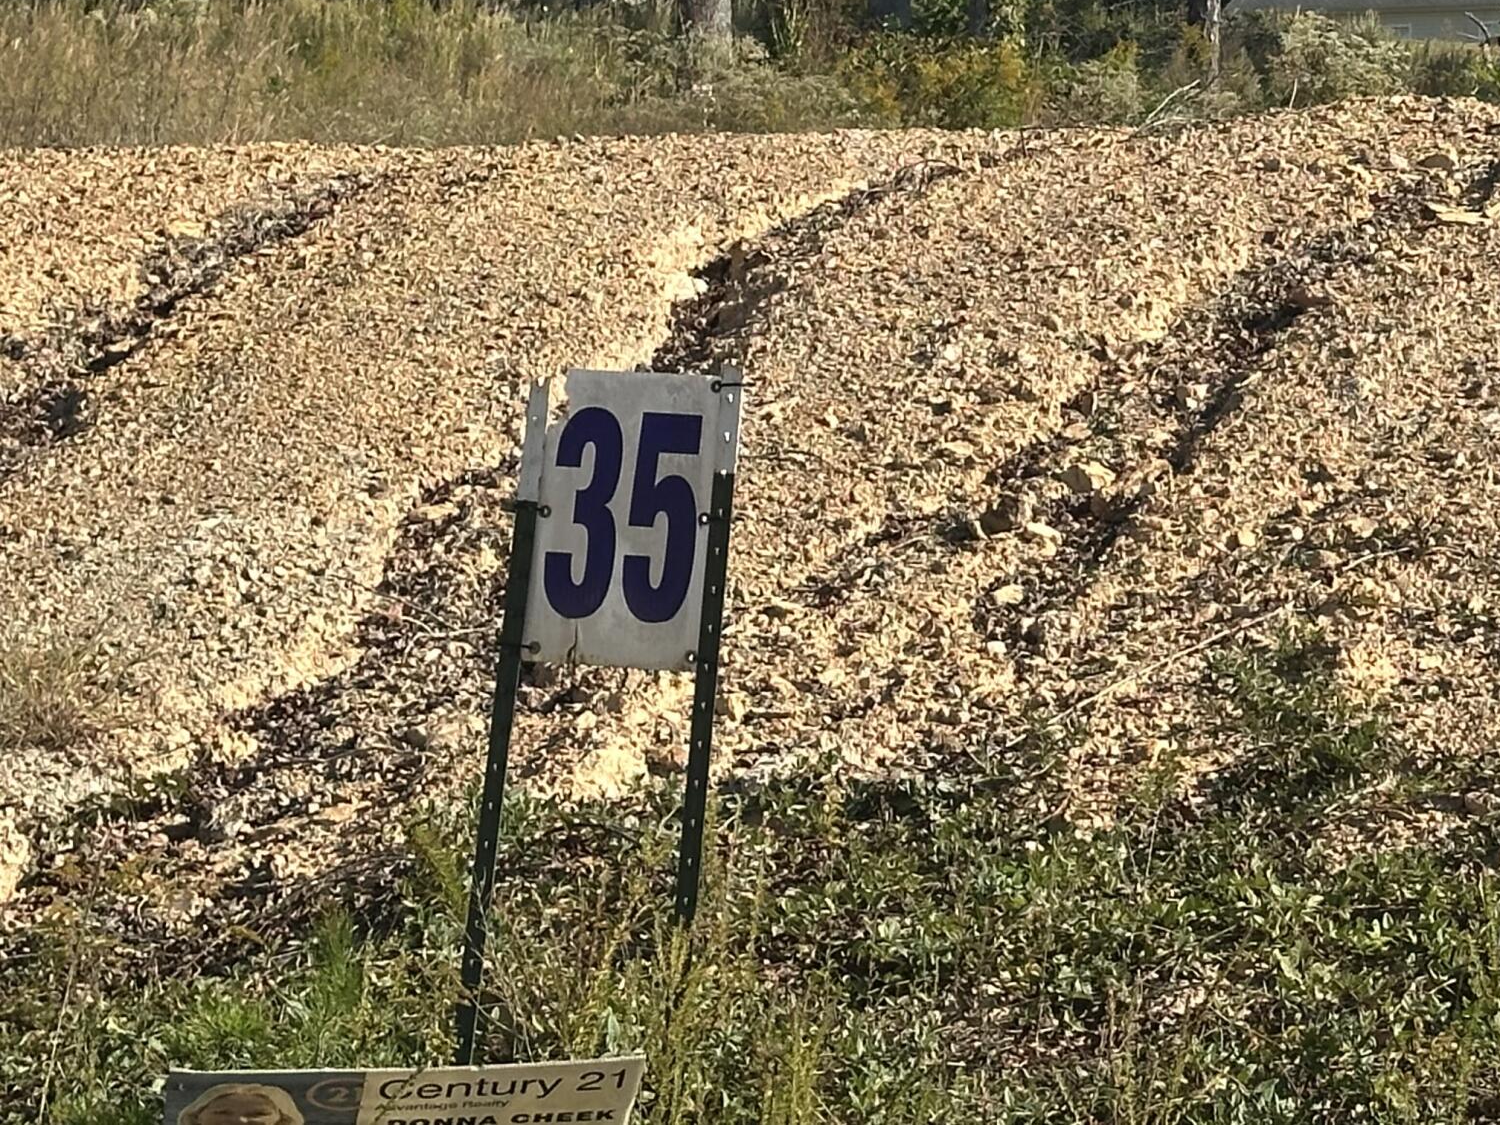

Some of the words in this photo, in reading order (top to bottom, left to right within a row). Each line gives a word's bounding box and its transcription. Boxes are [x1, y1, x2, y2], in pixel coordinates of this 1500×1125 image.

[544, 406, 703, 623] 35
[379, 1077, 562, 1099] Century
[576, 1069, 626, 1091] 21
[511, 1109, 616, 1123] CHEEK
